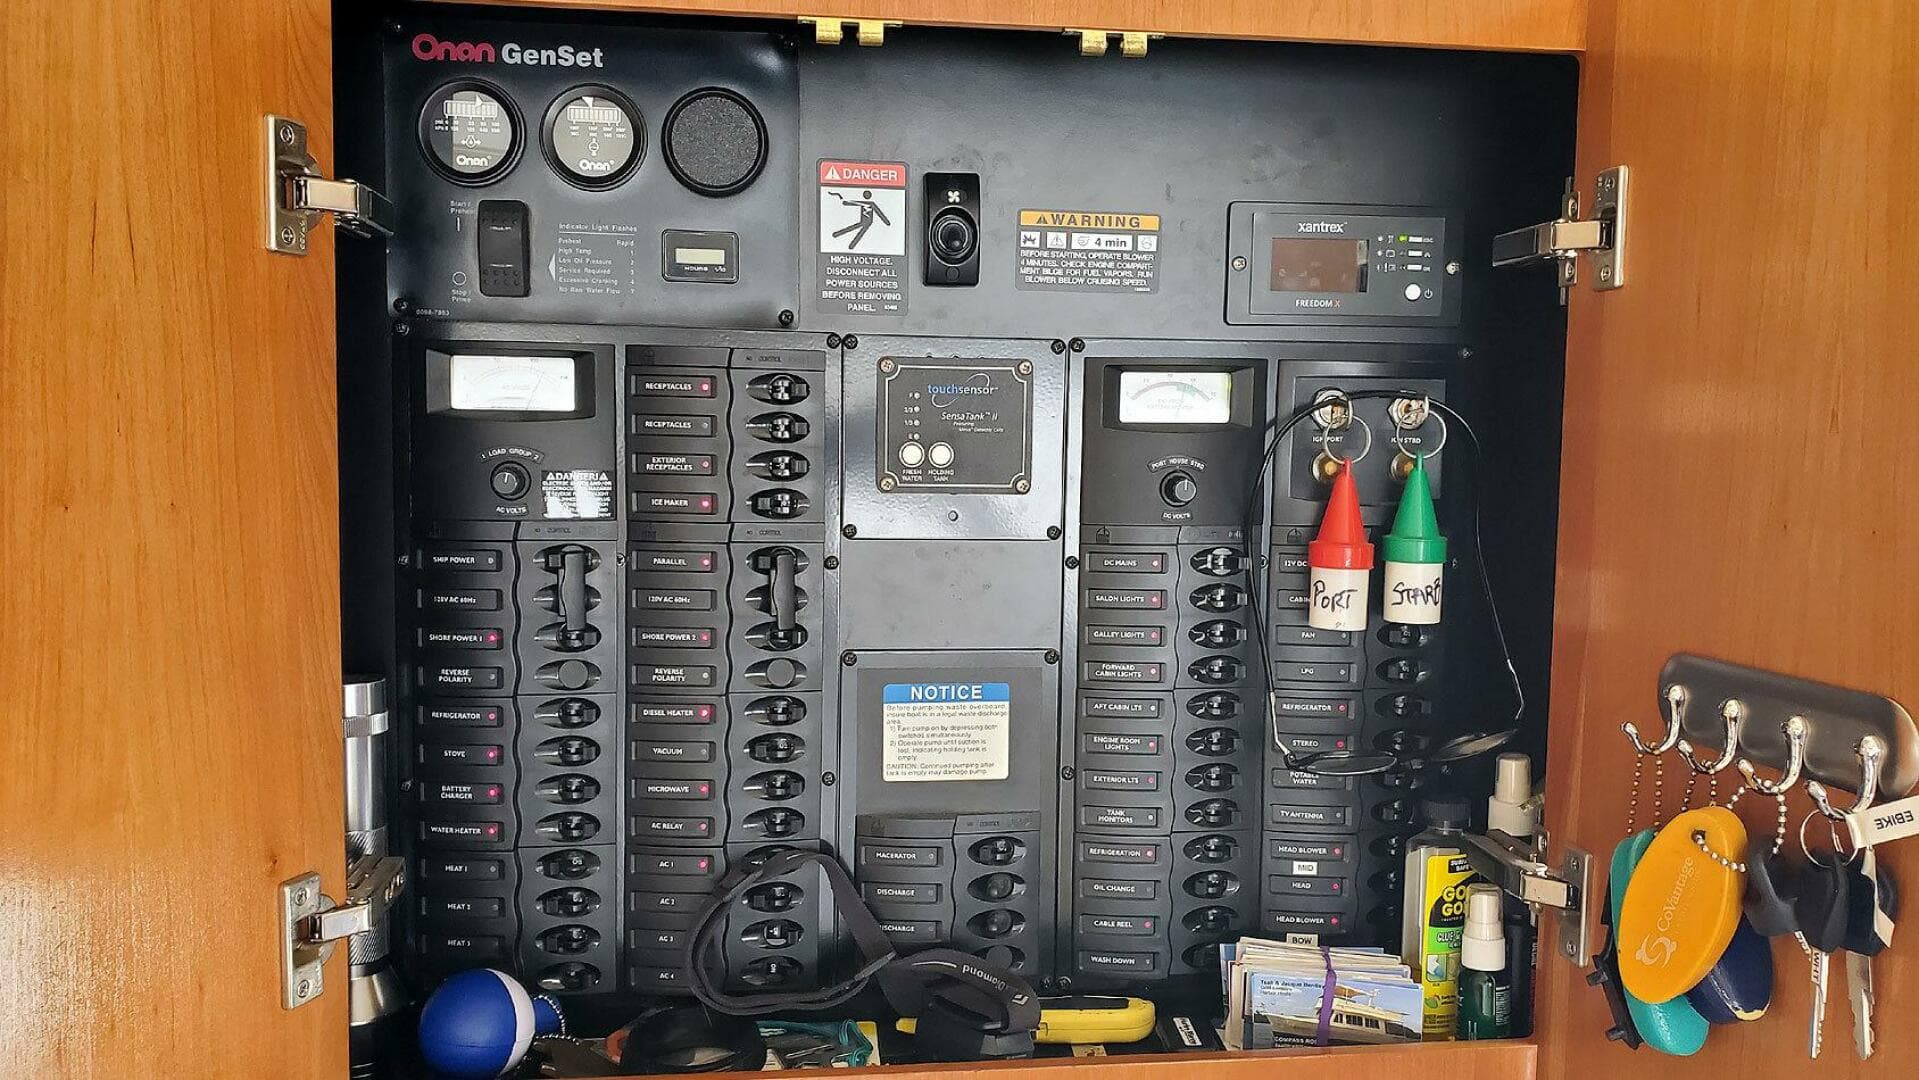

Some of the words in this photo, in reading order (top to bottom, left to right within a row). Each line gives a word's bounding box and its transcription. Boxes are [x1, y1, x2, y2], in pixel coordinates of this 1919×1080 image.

[412, 33, 495, 63] Onan
[501, 43, 603, 67] GenSet
[456, 155, 490, 167] Onan
[579, 159, 611, 171] Onan
[843, 170, 898, 181] DANGER
[1052, 214, 1141, 228] WARNING
[1298, 222, 1344, 233] xantrex
[1095, 238, 1102, 246] 4
[1106, 238, 1127, 247] min
[1020, 250, 1050, 258] BEFORE
[1090, 252, 1121, 260] OPERATE
[830, 256, 850, 264] HIGH
[854, 257, 893, 266] VOLTAGE.
[1061, 260, 1086, 268] CHECK
[1088, 260, 1114, 268] ENGINE
[827, 268, 880, 276] DISCONNECT
[1042, 268, 1064, 276] BILGE
[826, 280, 856, 288] POWER
[858, 280, 898, 288] SOURCES
[1025, 276, 1056, 284] BLOWER
[1087, 278, 1120, 286] CRUISING
[822, 290, 856, 299] BEFORE
[858, 292, 901, 300] REMOVING
[848, 303, 876, 312] PANEL.
[1296, 300, 1333, 308] FREEDOM
[928, 384, 994, 395] touchsensor
[941, 412, 985, 420] SensaTank
[645, 421, 692, 429] RECEPTACLES
[488, 448, 506, 457] LOAD
[509, 448, 532, 458] GROUP
[496, 506, 506, 514] AC
[653, 558, 687, 566] PARALLEL
[430, 634, 450, 642] SHORE
[452, 634, 478, 642] POWER
[438, 676, 472, 684] POLARITY
[911, 685, 983, 700] NOTICE
[1282, 704, 1332, 712] REFRIGERATOR
[432, 712, 481, 720] REFRIGERATOR
[1094, 736, 1119, 744] ENGINE
[444, 750, 466, 758] STOVE
[1126, 776, 1139, 784] LTS
[440, 792, 473, 800] CHARGER
[1290, 811, 1324, 819] ANTENNA
[1874, 810, 1914, 830] EBIKE
[431, 826, 454, 834] WATER
[652, 822, 662, 830] AC
[876, 852, 916, 860] MACERATOR
[1089, 848, 1141, 856] REFRIGERATION
[1298, 864, 1314, 872] MID
[876, 888, 915, 896] DISCHARGE
[1091, 956, 1112, 964] WASH
[1812, 952, 1820, 982] WHT
[660, 972, 670, 980] AC
[962, 964, 1007, 992] Diamond
